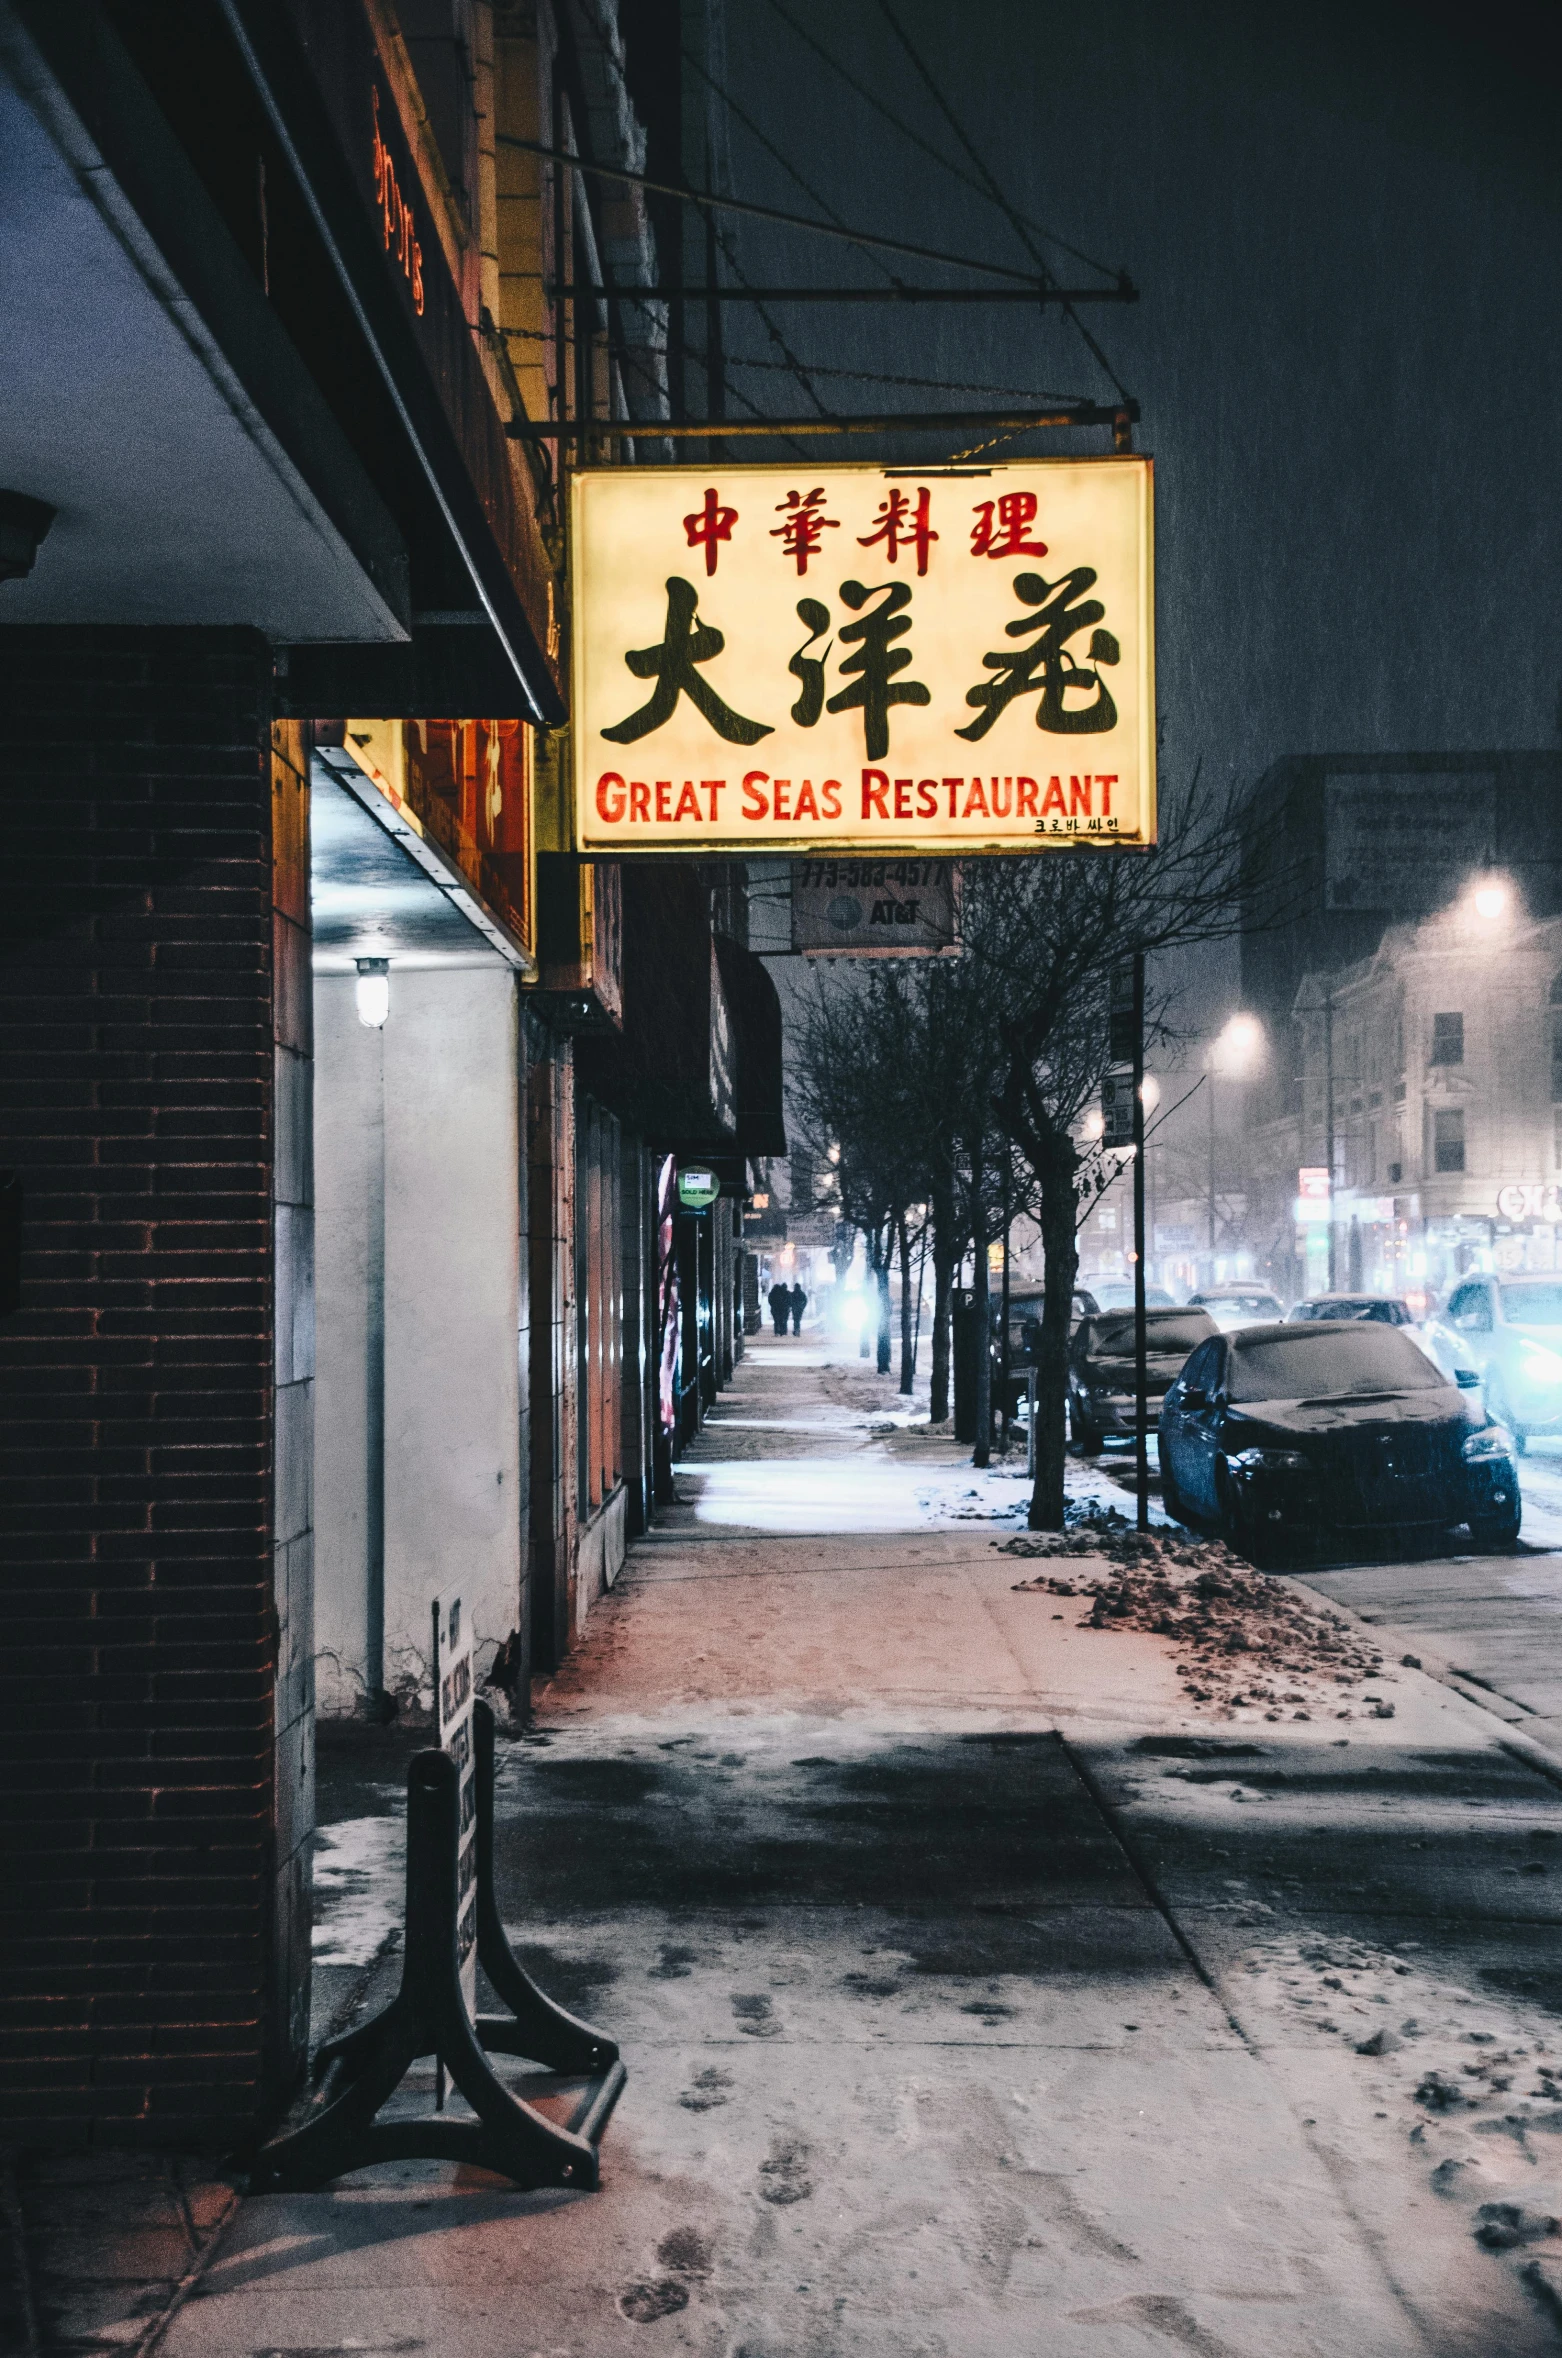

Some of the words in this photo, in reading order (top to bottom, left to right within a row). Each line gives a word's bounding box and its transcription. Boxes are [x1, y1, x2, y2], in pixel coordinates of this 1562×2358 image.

[683, 487, 1048, 577] 中華料理
[596, 771, 727, 823] GREAT
[742, 770, 842, 821] SEAS
[860, 768, 1119, 820] RESTAURANT
[869, 900, 919, 925] AT&T
[965, 1293, 973, 1306] P
